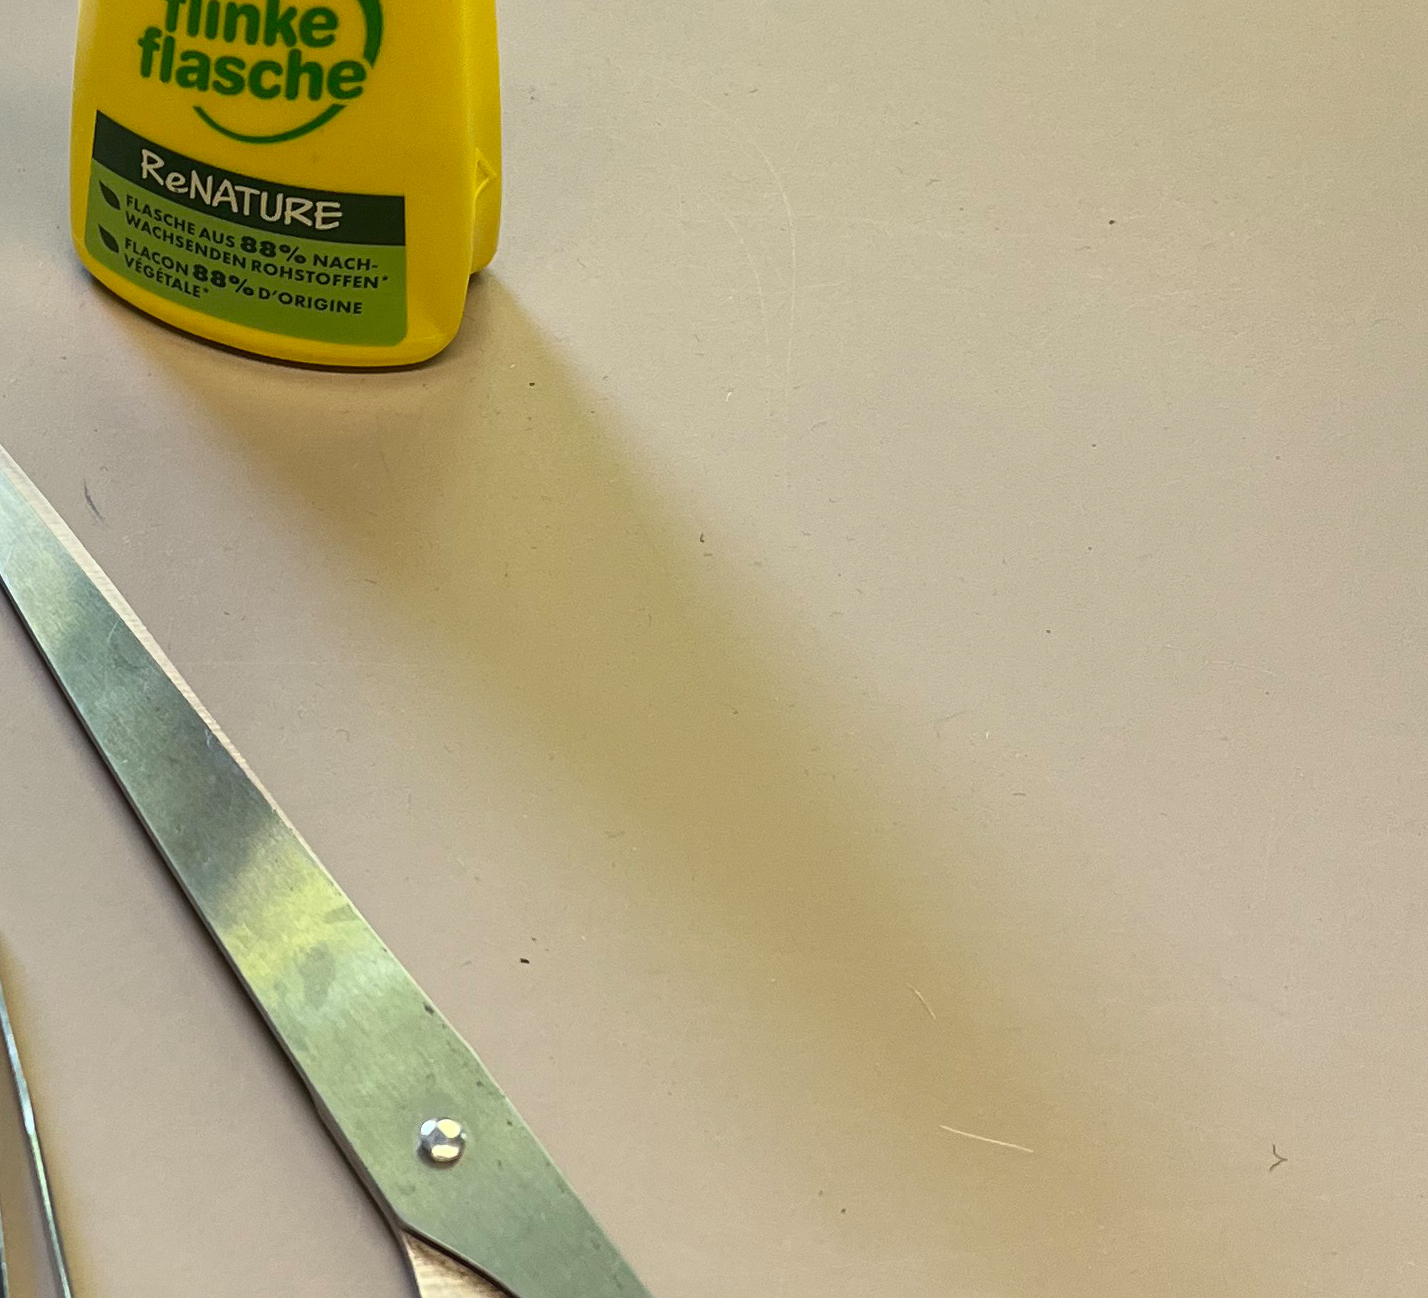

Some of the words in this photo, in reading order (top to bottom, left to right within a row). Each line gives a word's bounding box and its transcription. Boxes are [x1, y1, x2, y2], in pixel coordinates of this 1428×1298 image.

[138, 26, 368, 102] flasche
[140, 148, 344, 231] ReNATURE
[125, 194, 196, 236] FLASCHE
[198, 226, 235, 248] AUS
[239, 235, 307, 264] 88%
[312, 254, 379, 271] NACH-
[125, 210, 247, 269] WACHSENDEN
[124, 237, 189, 277] FLACON
[192, 263, 254, 297] 88%
[258, 286, 363, 315] D'ORIGINE
